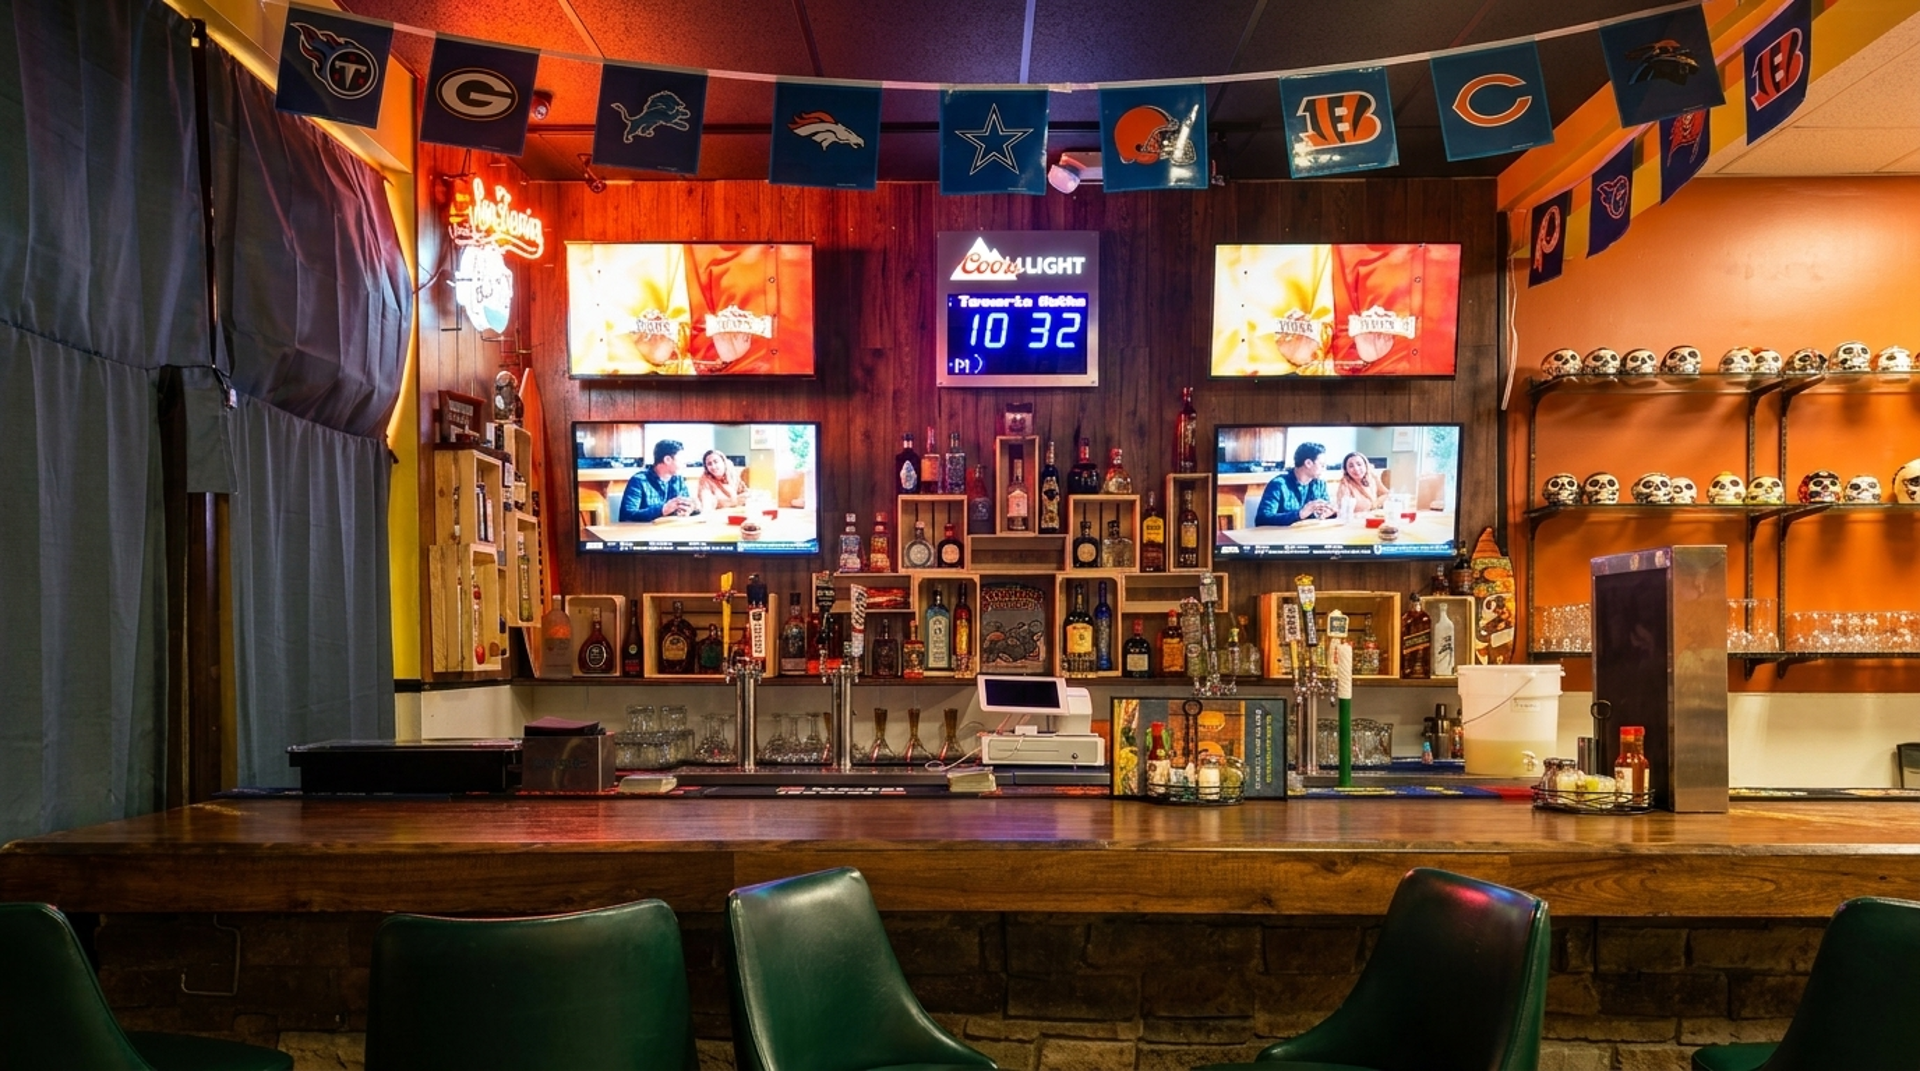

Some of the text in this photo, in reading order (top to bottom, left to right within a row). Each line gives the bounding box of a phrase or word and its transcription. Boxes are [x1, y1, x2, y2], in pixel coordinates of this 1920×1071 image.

[334, 60, 368, 90] T
[441, 73, 513, 116] G
[1452, 73, 1533, 127] C
[1296, 90, 1382, 150] B
[961, 252, 1086, 275] Coors LIGHT
[970, 312, 1081, 348] 10 32
